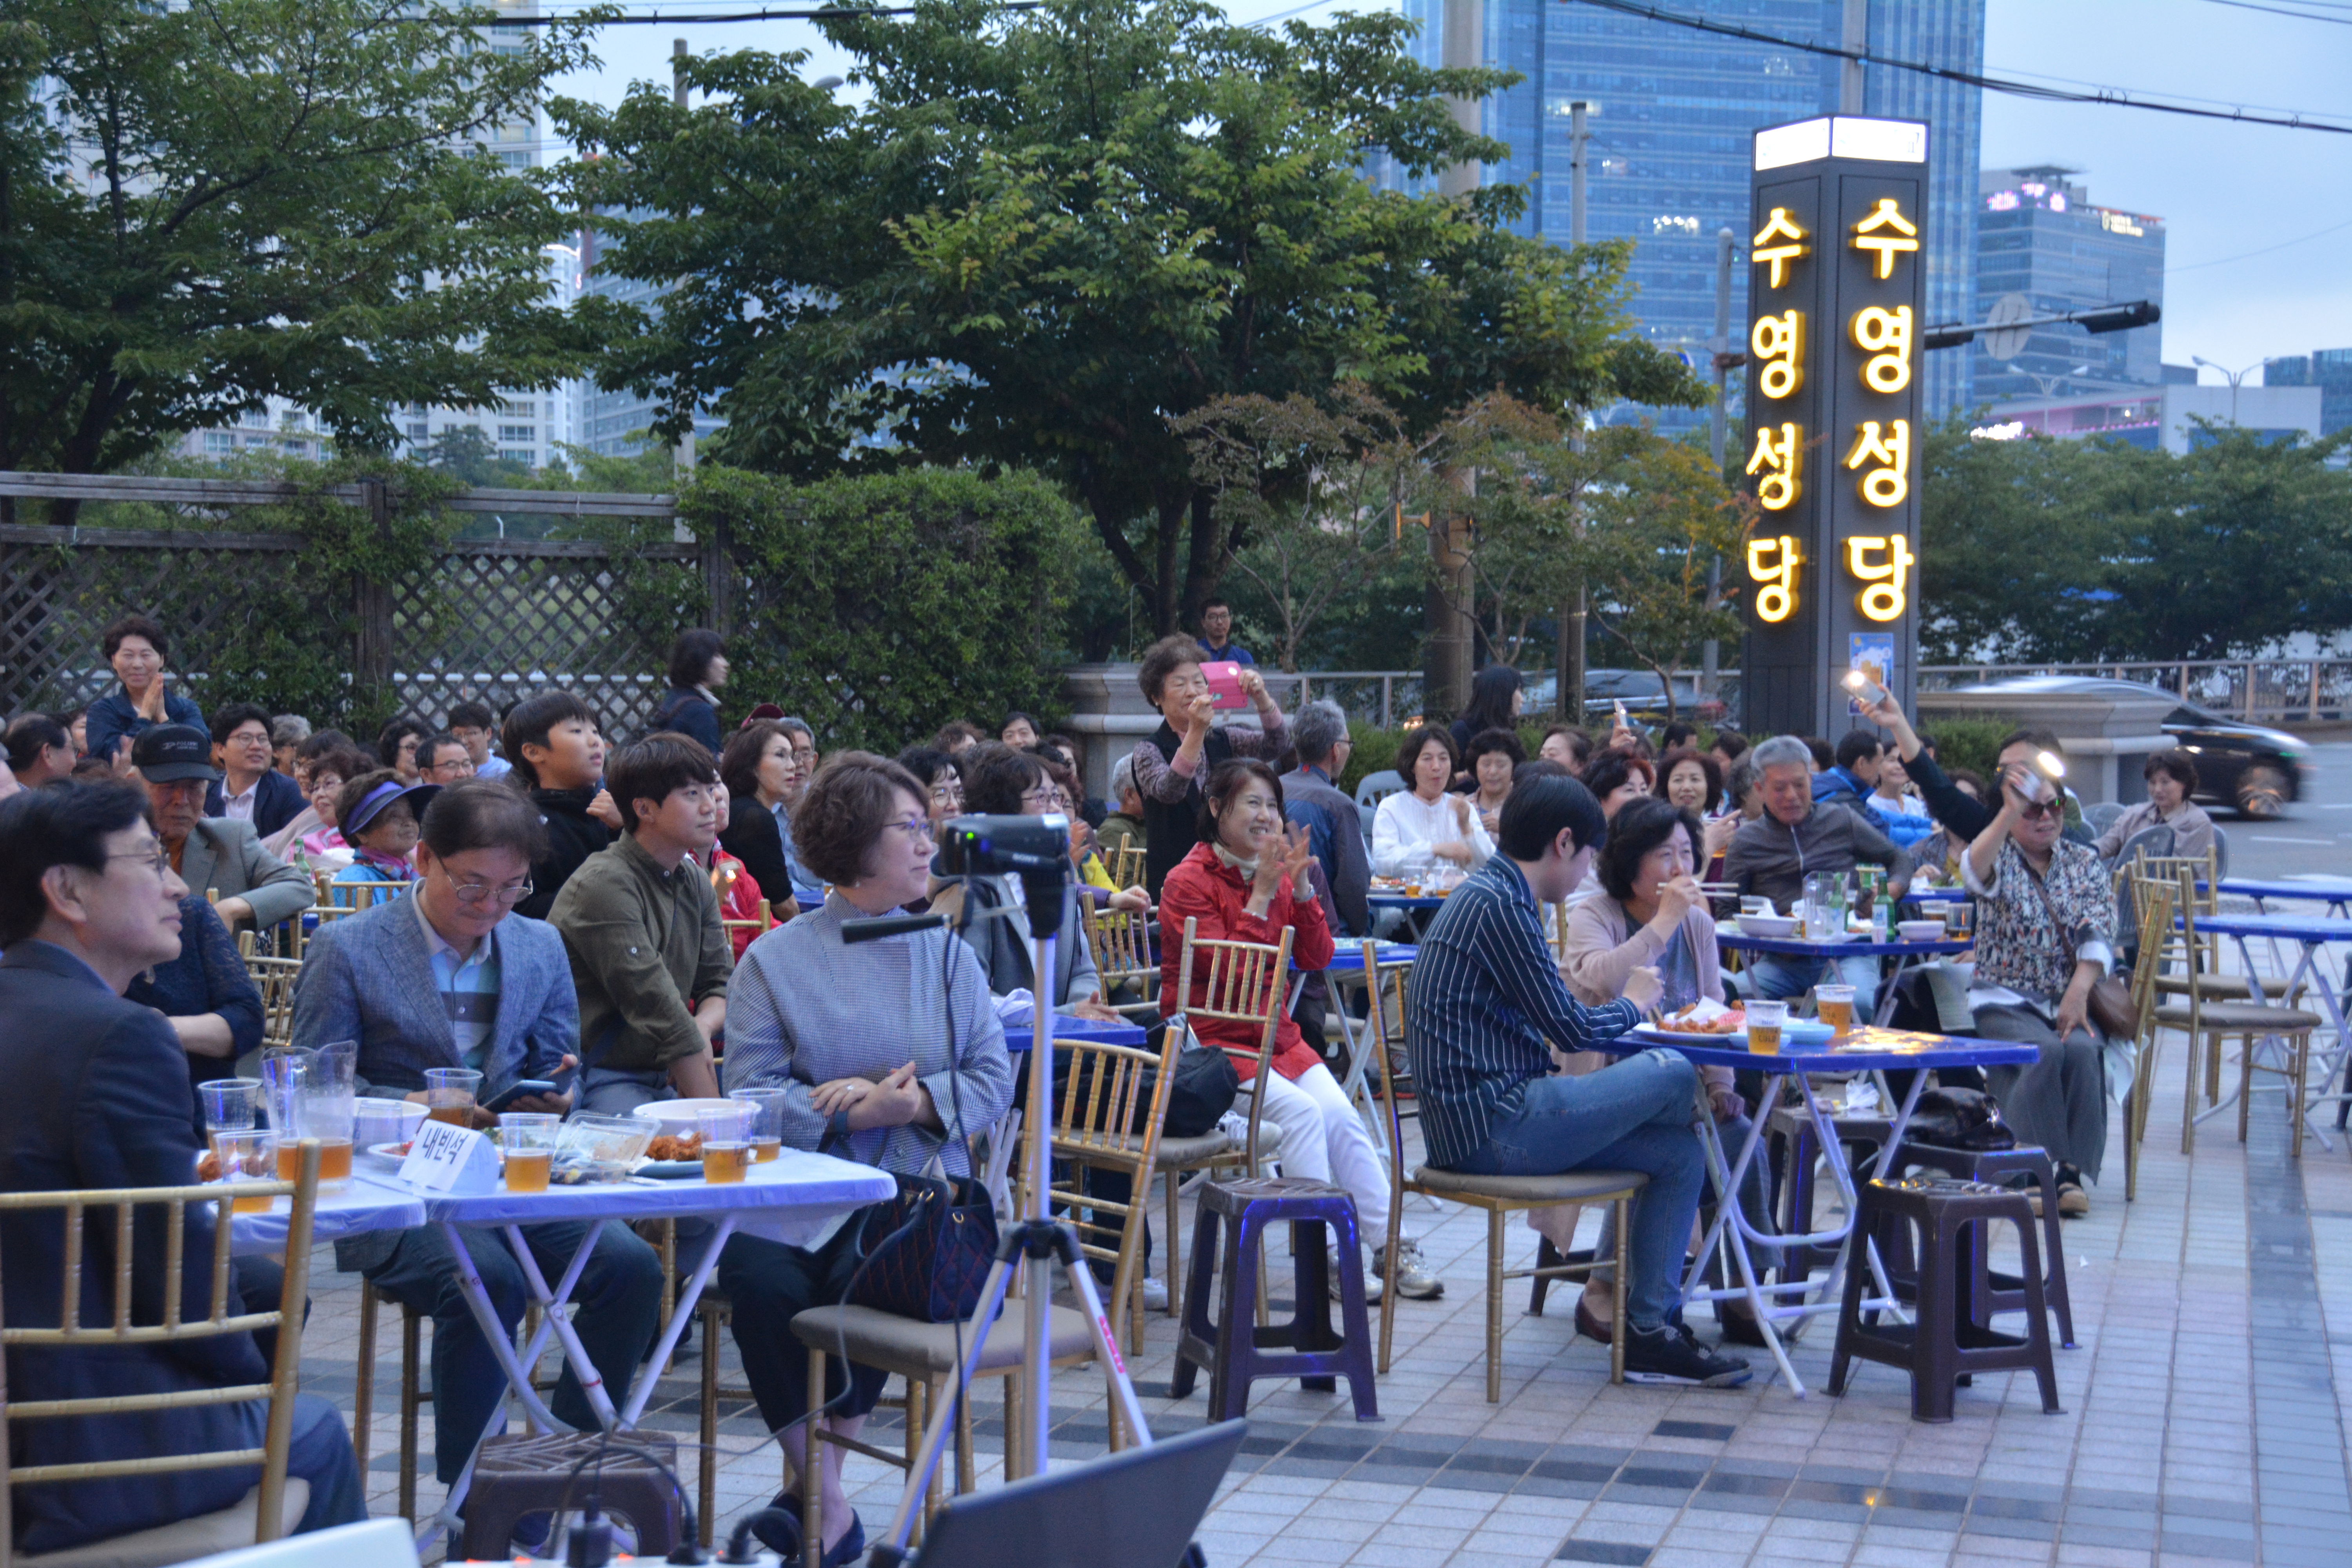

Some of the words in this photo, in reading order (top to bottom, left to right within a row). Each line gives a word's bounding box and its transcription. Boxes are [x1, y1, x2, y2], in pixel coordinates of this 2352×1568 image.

[1746, 208, 1804, 622] 수영성당
[1847, 198, 1919, 622] 수영성당
[1012, 853, 1039, 863] SONY
[422, 1127, 470, 1165] 내빈석
